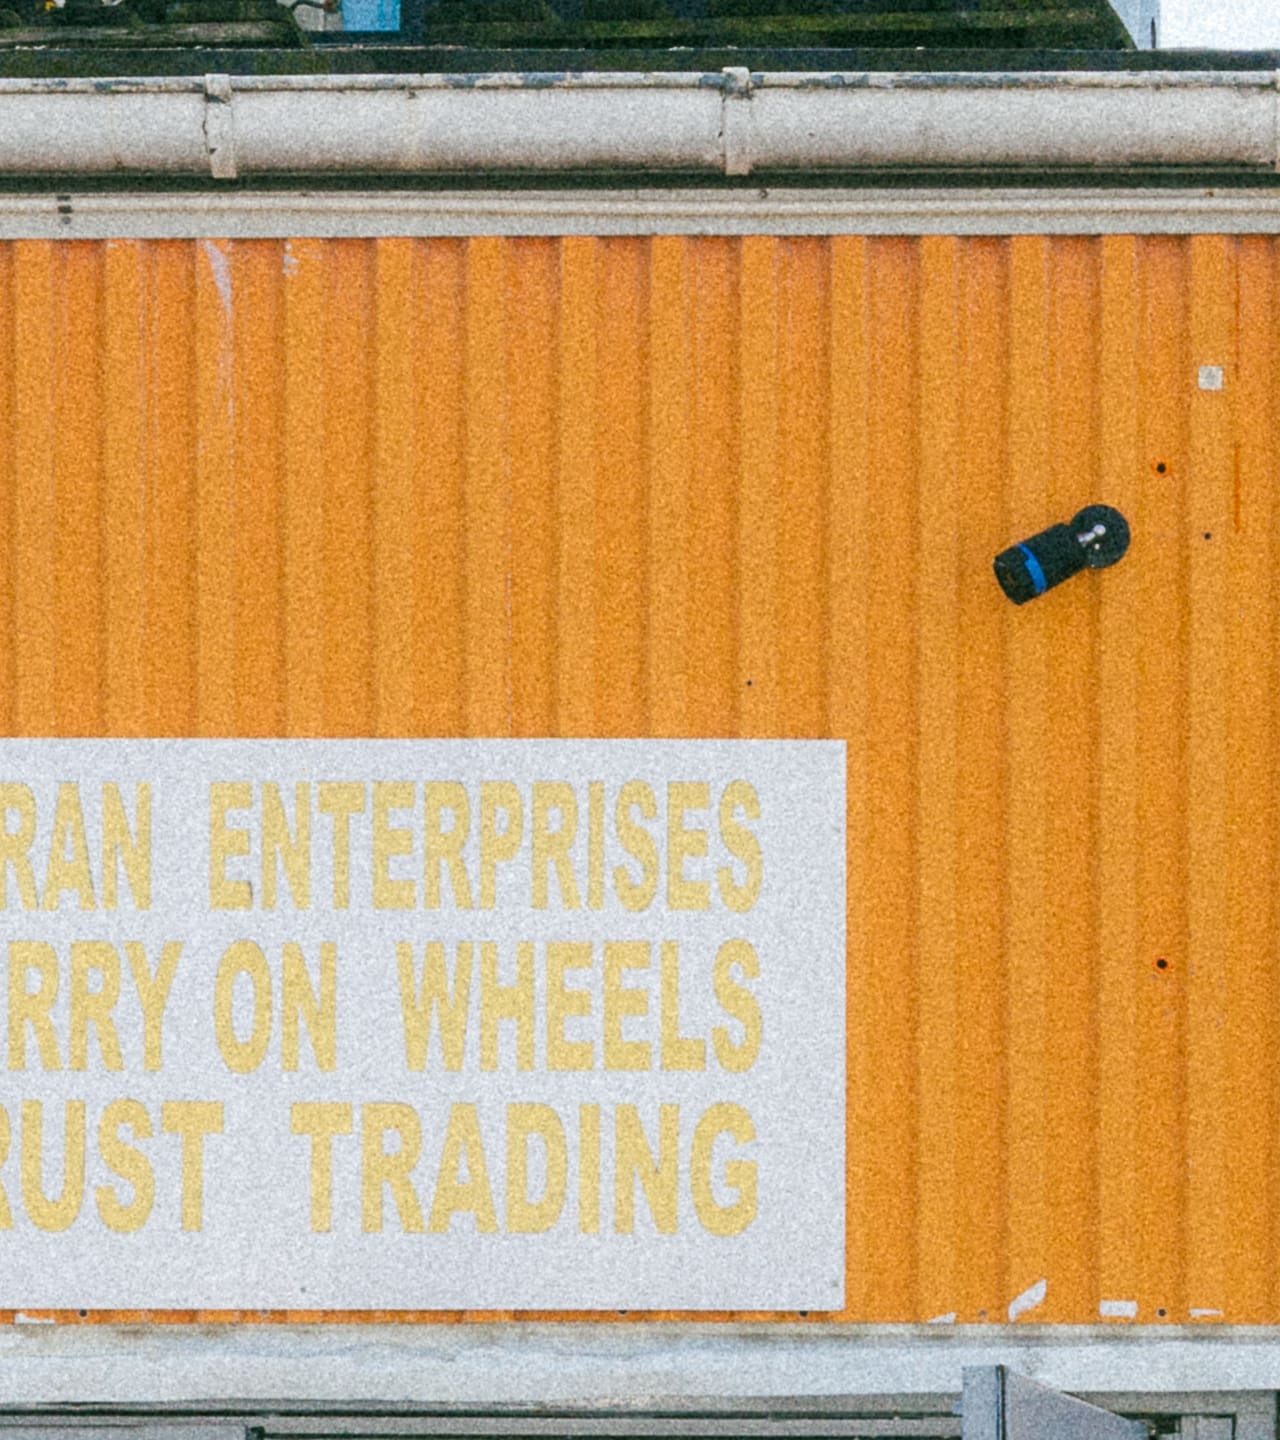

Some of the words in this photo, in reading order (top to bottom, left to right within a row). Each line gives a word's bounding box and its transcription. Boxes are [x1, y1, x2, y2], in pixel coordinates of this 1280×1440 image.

[207, 780, 764, 912] ENTERPRISES
[212, 938, 338, 1073] ON
[394, 938, 763, 1073] WHEELS
[288, 1101, 759, 1237] TRADING
